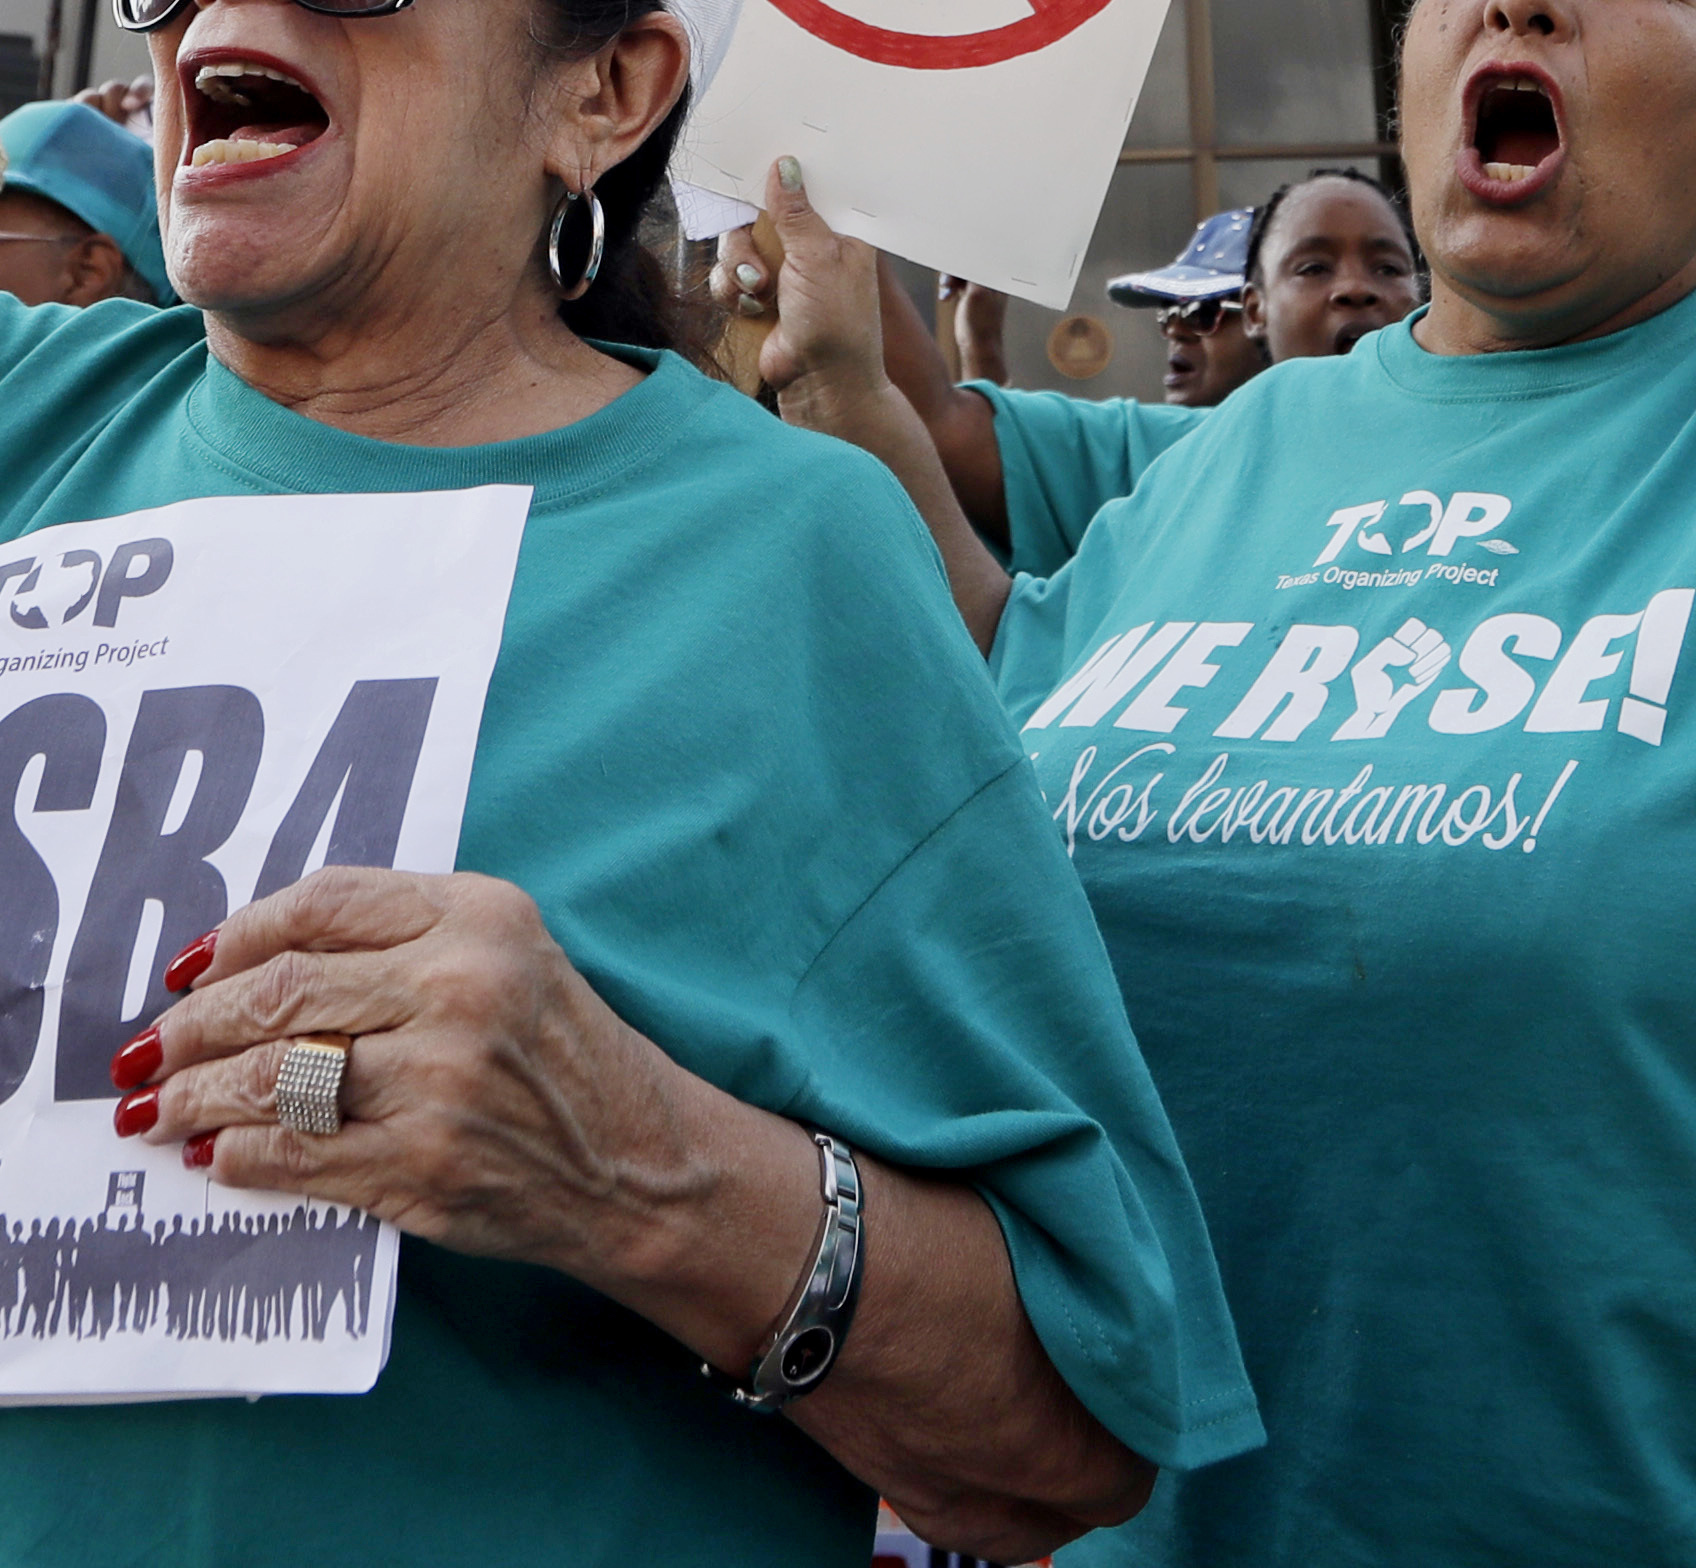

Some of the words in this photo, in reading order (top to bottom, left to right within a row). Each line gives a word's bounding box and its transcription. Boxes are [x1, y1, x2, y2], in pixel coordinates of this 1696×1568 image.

[1313, 490, 1512, 568] TOP
[1275, 572, 1320, 590] Texas
[1323, 565, 1424, 590] Organizing
[1424, 562, 1500, 587] Project
[94, 636, 171, 668] Project
[1019, 620, 1255, 733] WE
[1167, 752, 1579, 853] levantamos!
